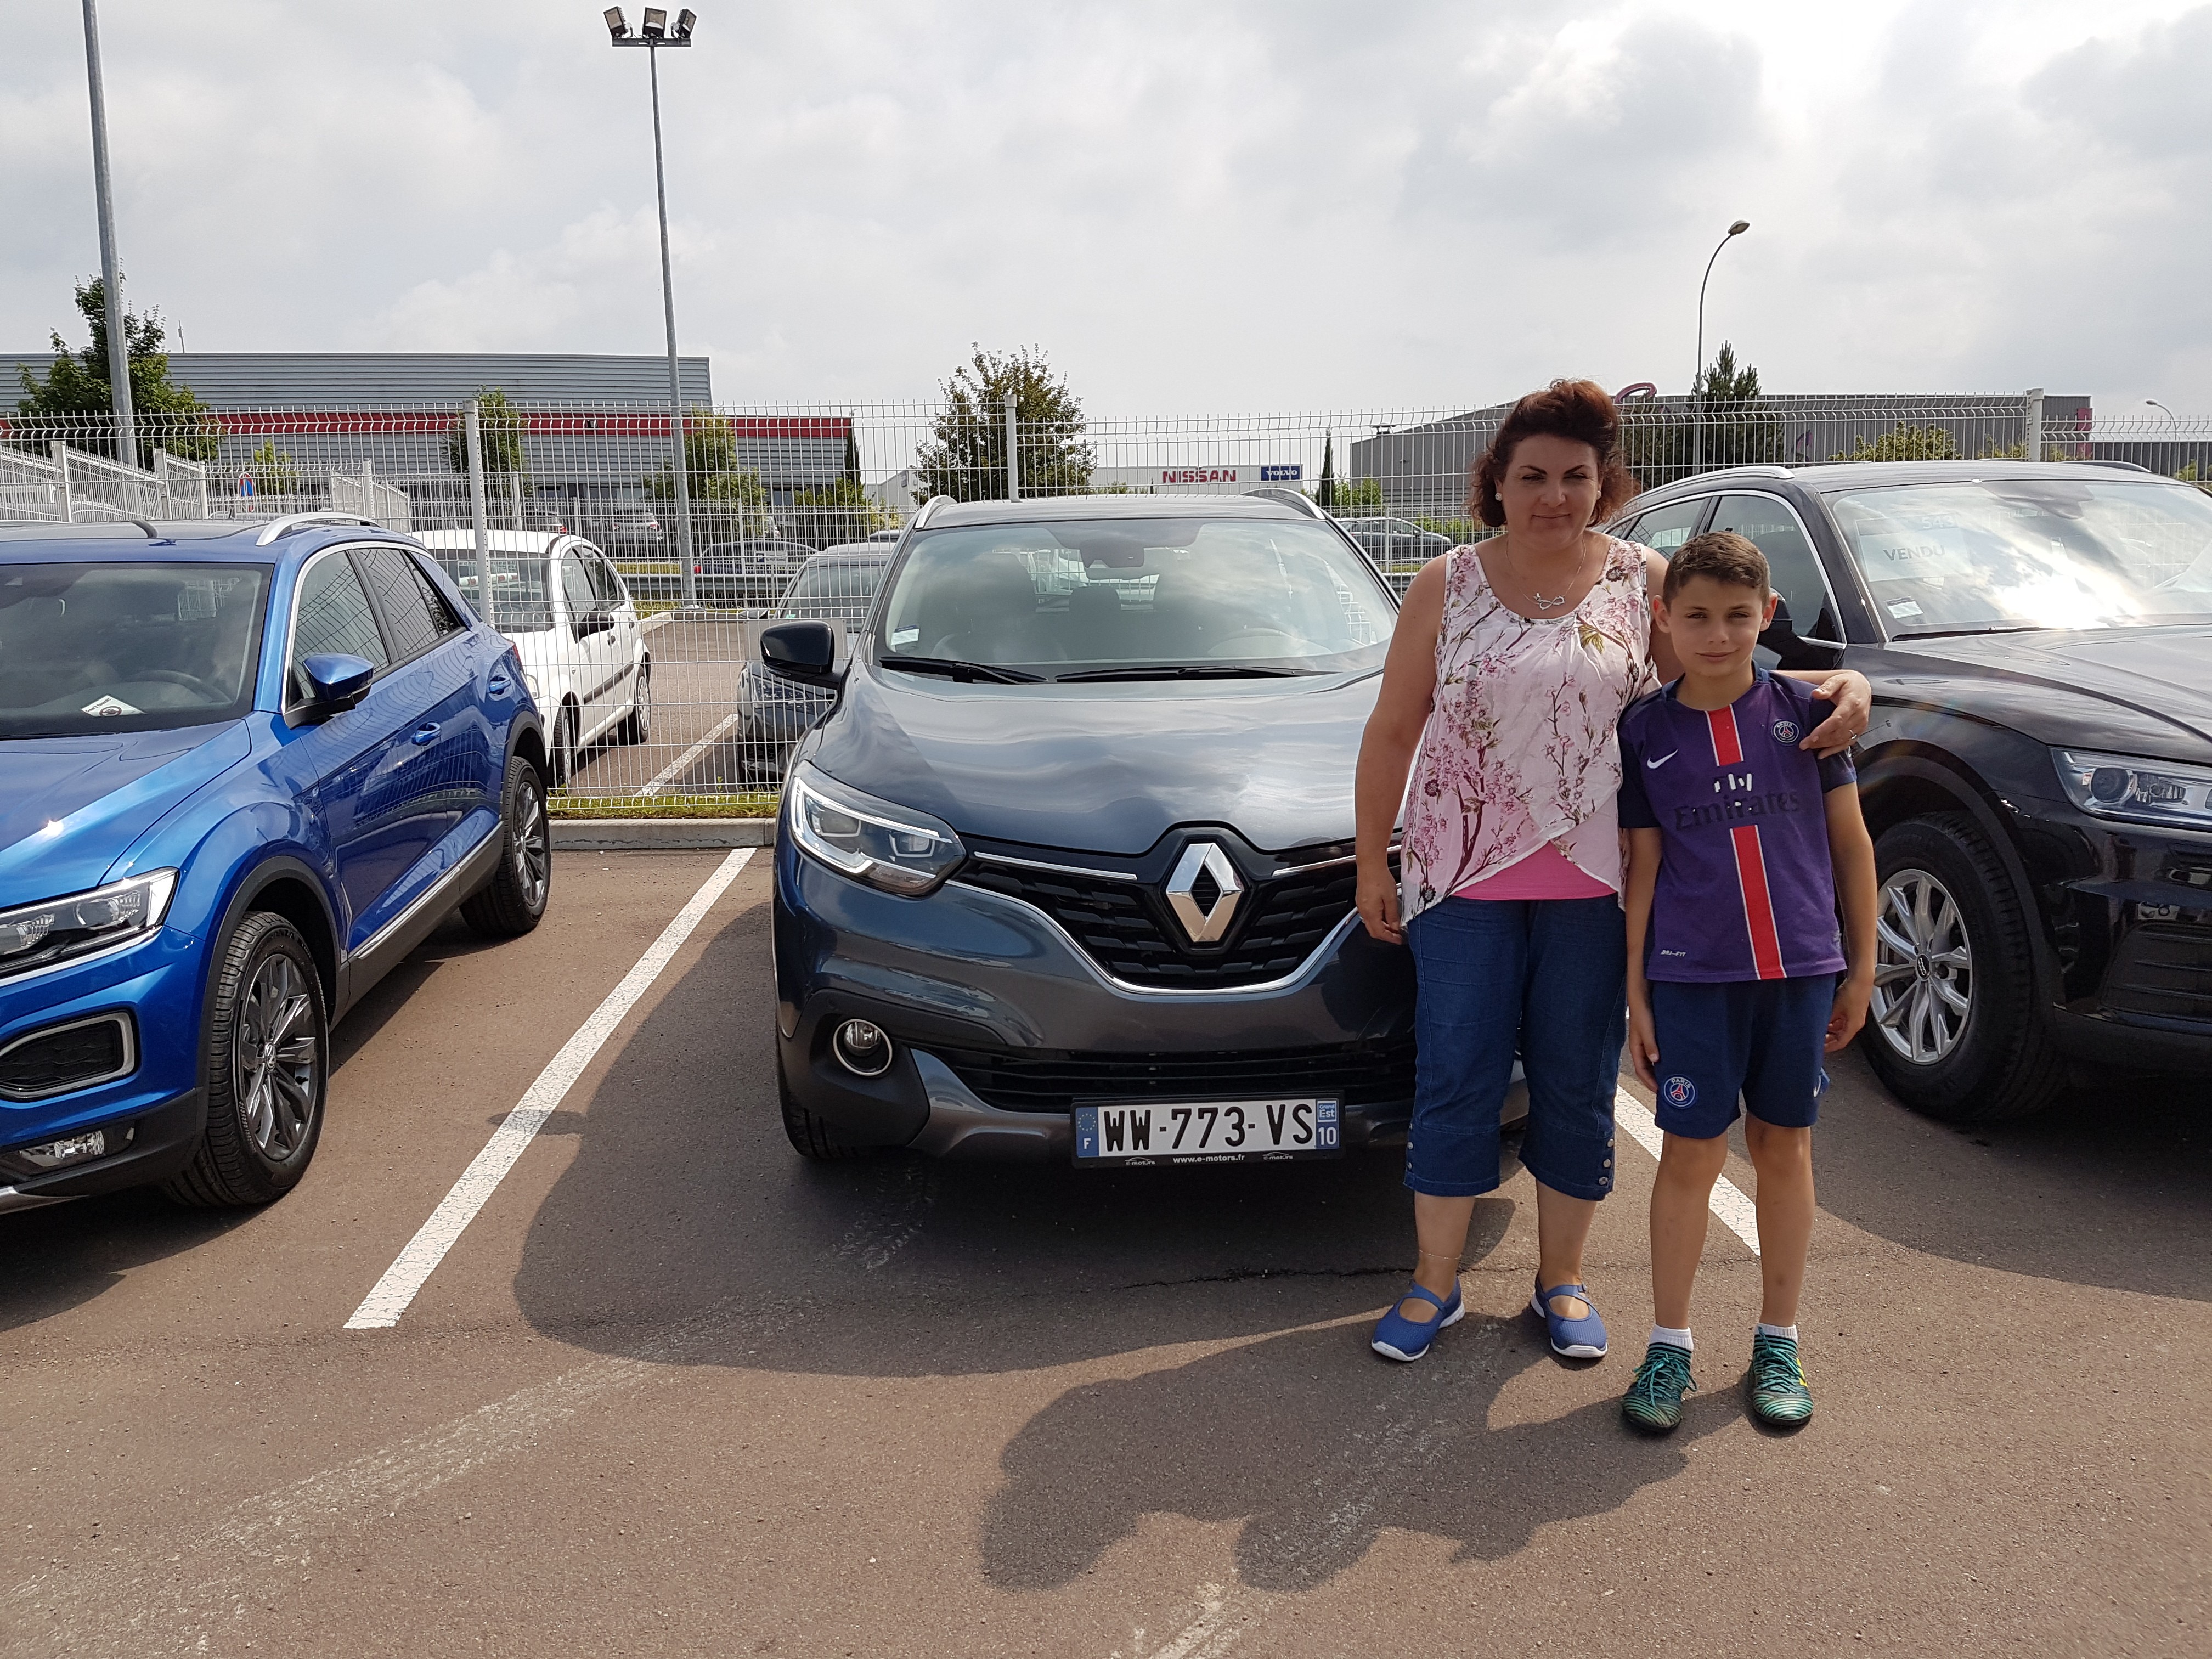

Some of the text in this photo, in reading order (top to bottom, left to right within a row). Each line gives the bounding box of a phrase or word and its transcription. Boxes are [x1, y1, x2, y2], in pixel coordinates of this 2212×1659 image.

[1163, 470, 1237, 483] NISSAN
[1883, 545, 1945, 561] VENDU
[1674, 791, 1799, 831] Emirates
[1671, 1078, 1692, 1088] PARIS
[1319, 1109, 1335, 1118] Est
[1318, 1126, 1336, 1146] 10
[1084, 1138, 1091, 1149] F
[1173, 1154, 1245, 1163] www.e-motors.fr
